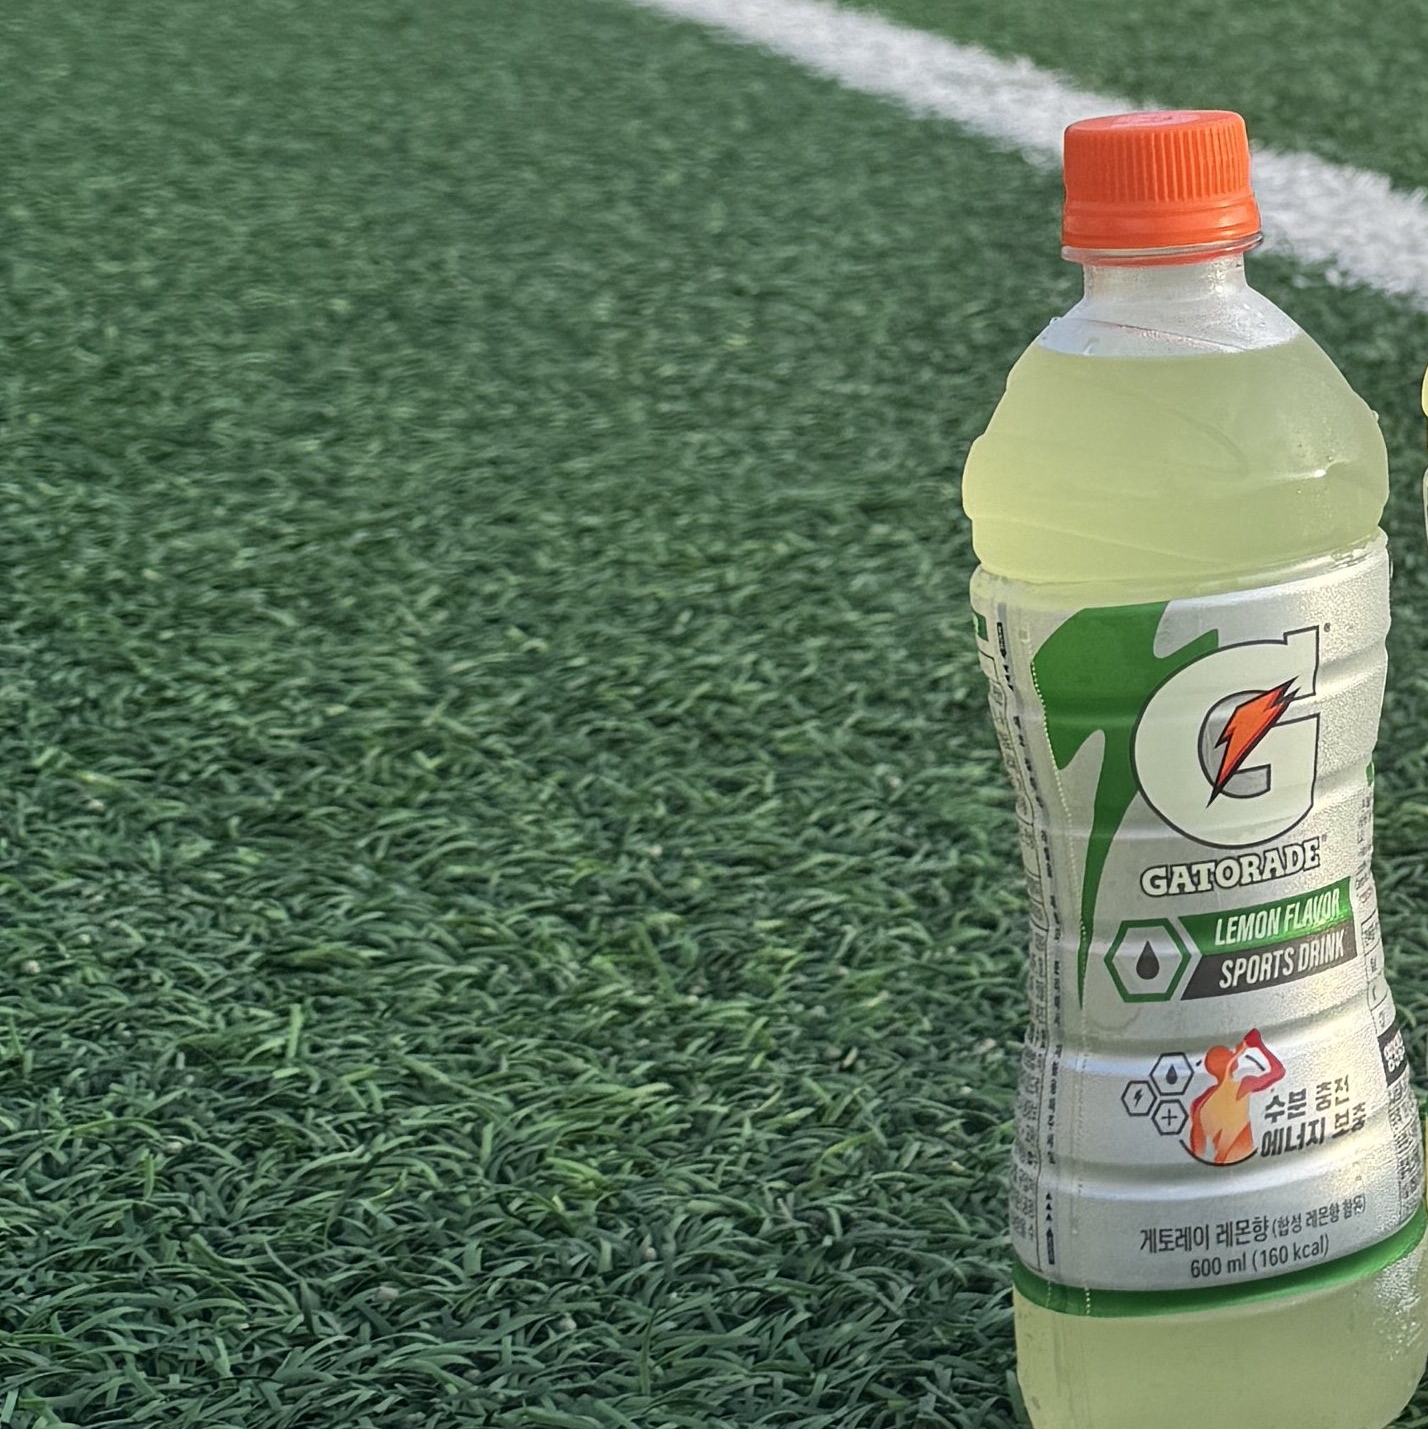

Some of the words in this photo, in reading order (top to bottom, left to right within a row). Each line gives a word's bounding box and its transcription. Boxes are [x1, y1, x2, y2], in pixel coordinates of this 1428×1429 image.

[1133, 625, 1320, 847] G
[1140, 838, 1320, 898] GATORADE
[1214, 907, 1281, 947] LEMON
[1283, 888, 1342, 935] FLAVOR
[1219, 951, 1296, 990] SPORTS
[1298, 929, 1346, 972] DRINK
[1263, 1087, 1307, 1124] 수분
[1315, 1074, 1350, 1112] 충전
[1260, 1117, 1326, 1158] 에너지
[1331, 1101, 1367, 1139] 보충
[1139, 1224, 1210, 1254] 게토레이
[1215, 1215, 1270, 1248] 레몬향
[1272, 1214, 1302, 1238] (합성
[1305, 1202, 1340, 1229] 레몬향
[1190, 1258, 1222, 1279] 600
[1227, 1252, 1247, 1274] ml
[1252, 1246, 1289, 1273] (160
[1293, 1233, 1329, 1261] kcal)
